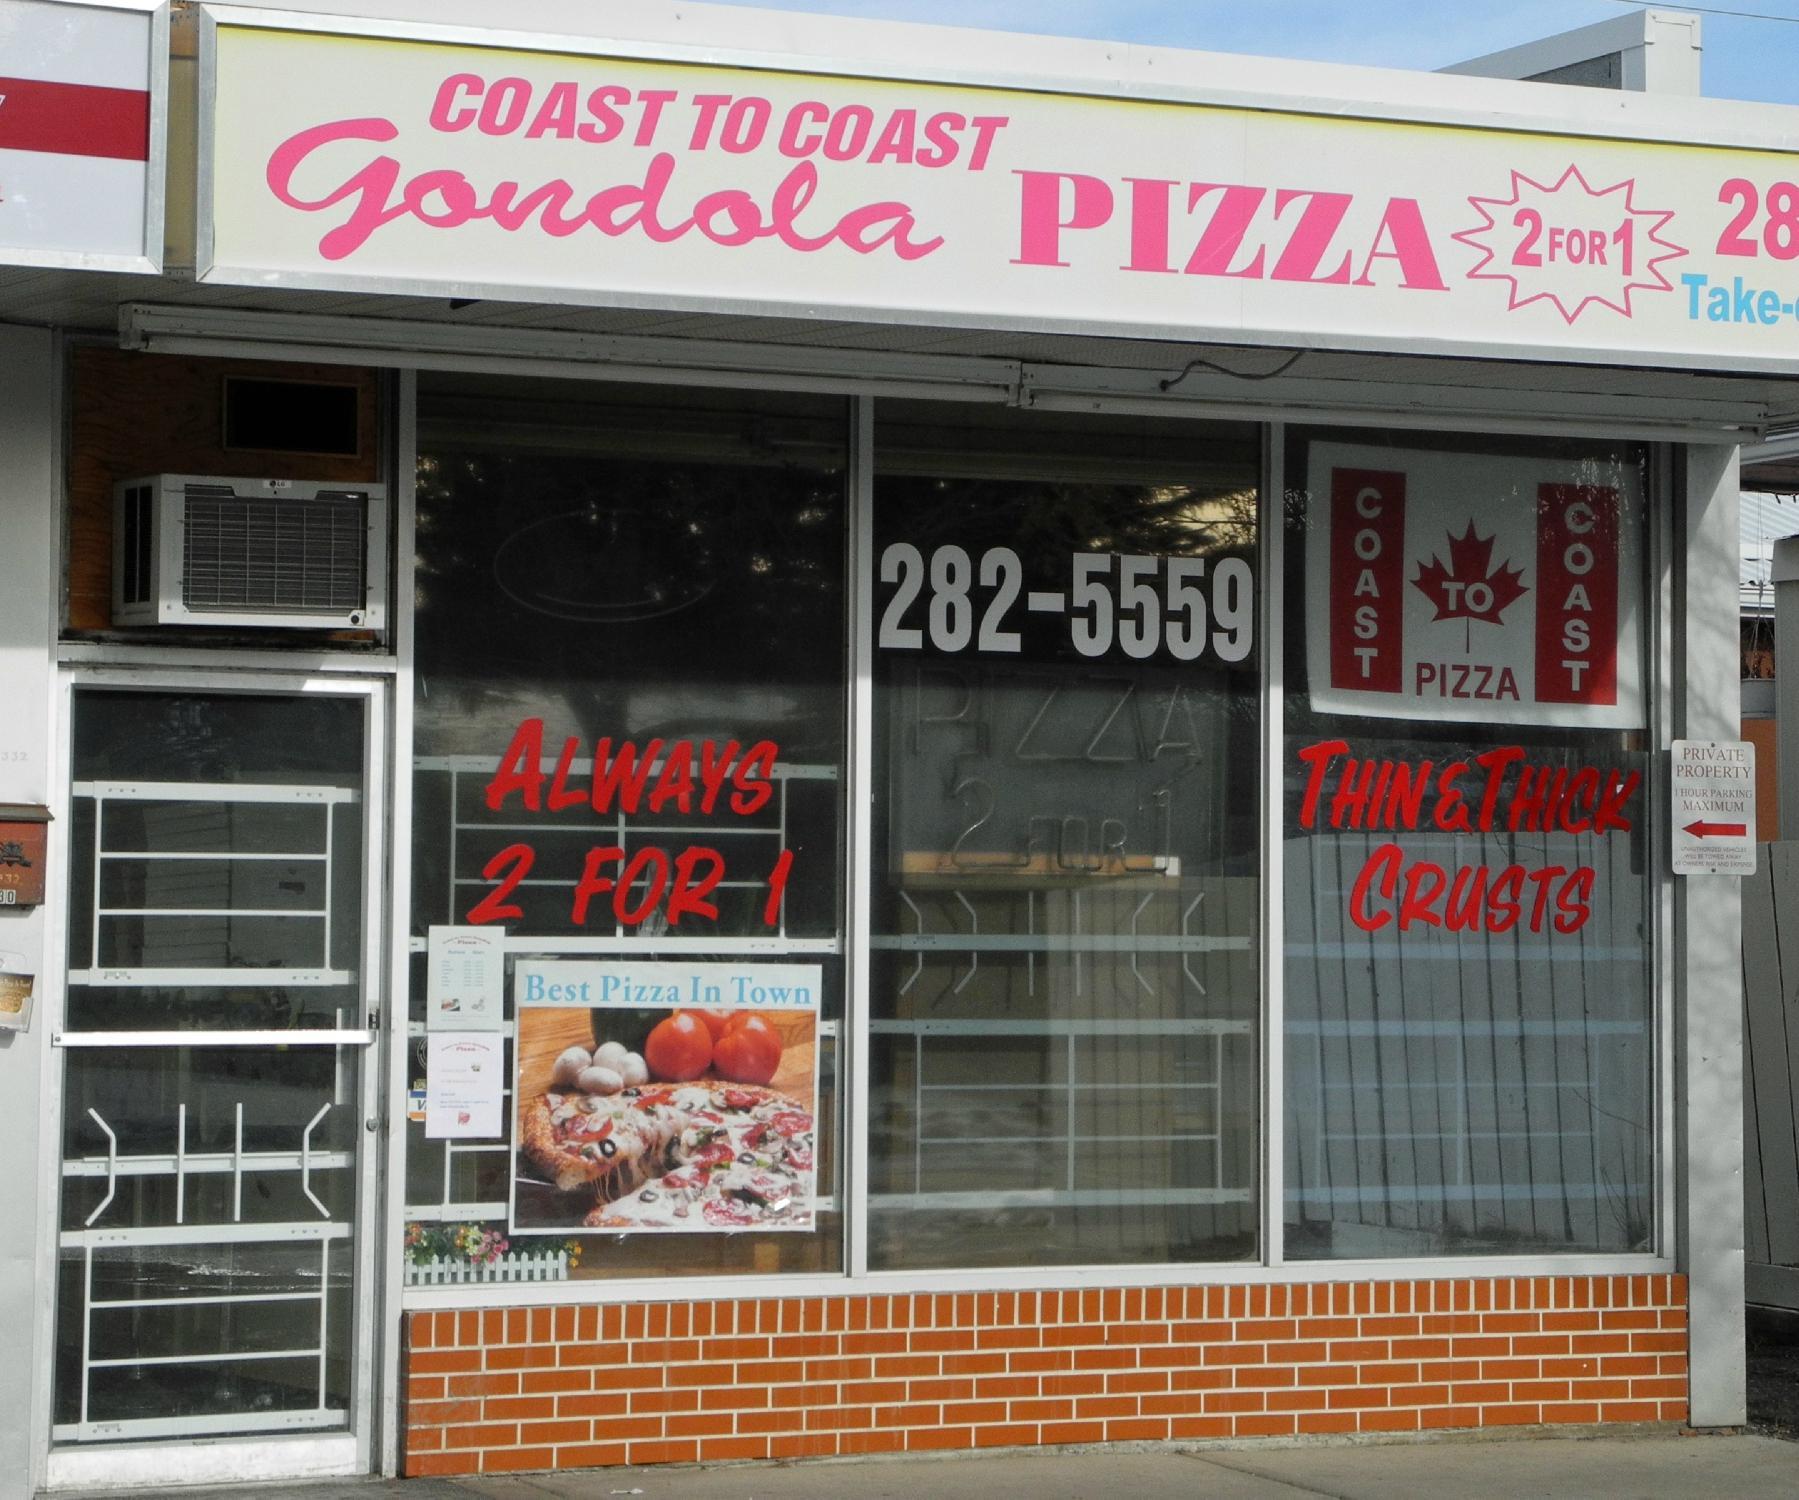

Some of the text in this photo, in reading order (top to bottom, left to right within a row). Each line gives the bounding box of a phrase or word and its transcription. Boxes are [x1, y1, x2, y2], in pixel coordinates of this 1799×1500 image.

[431, 73, 1008, 172] COAST TO COAST
[266, 117, 944, 261] Gondola
[1010, 169, 1450, 292] PIZZA
[1511, 208, 1634, 277] 2 FOR 1
[1681, 272, 1799, 327] Take-
[879, 541, 1254, 662] 282-5559
[1353, 486, 1383, 679] COAST
[1441, 580, 1496, 613] TO
[1561, 501, 1596, 692] COAST
[1415, 661, 1521, 701] PIZZA
[484, 717, 780, 816] ALWAYS
[1676, 764, 1752, 779] PROPERTY
[1683, 747, 1745, 762] PRIVATE
[1680, 788, 1708, 798] HOUR
[1710, 789, 1753, 799] PARKING
[1683, 800, 1744, 813] MAXIMUM
[466, 843, 795, 927] 2 FOR 1
[1349, 842, 1597, 934] CRUSTS
[525, 974, 813, 1006] Best Pizza In Town
